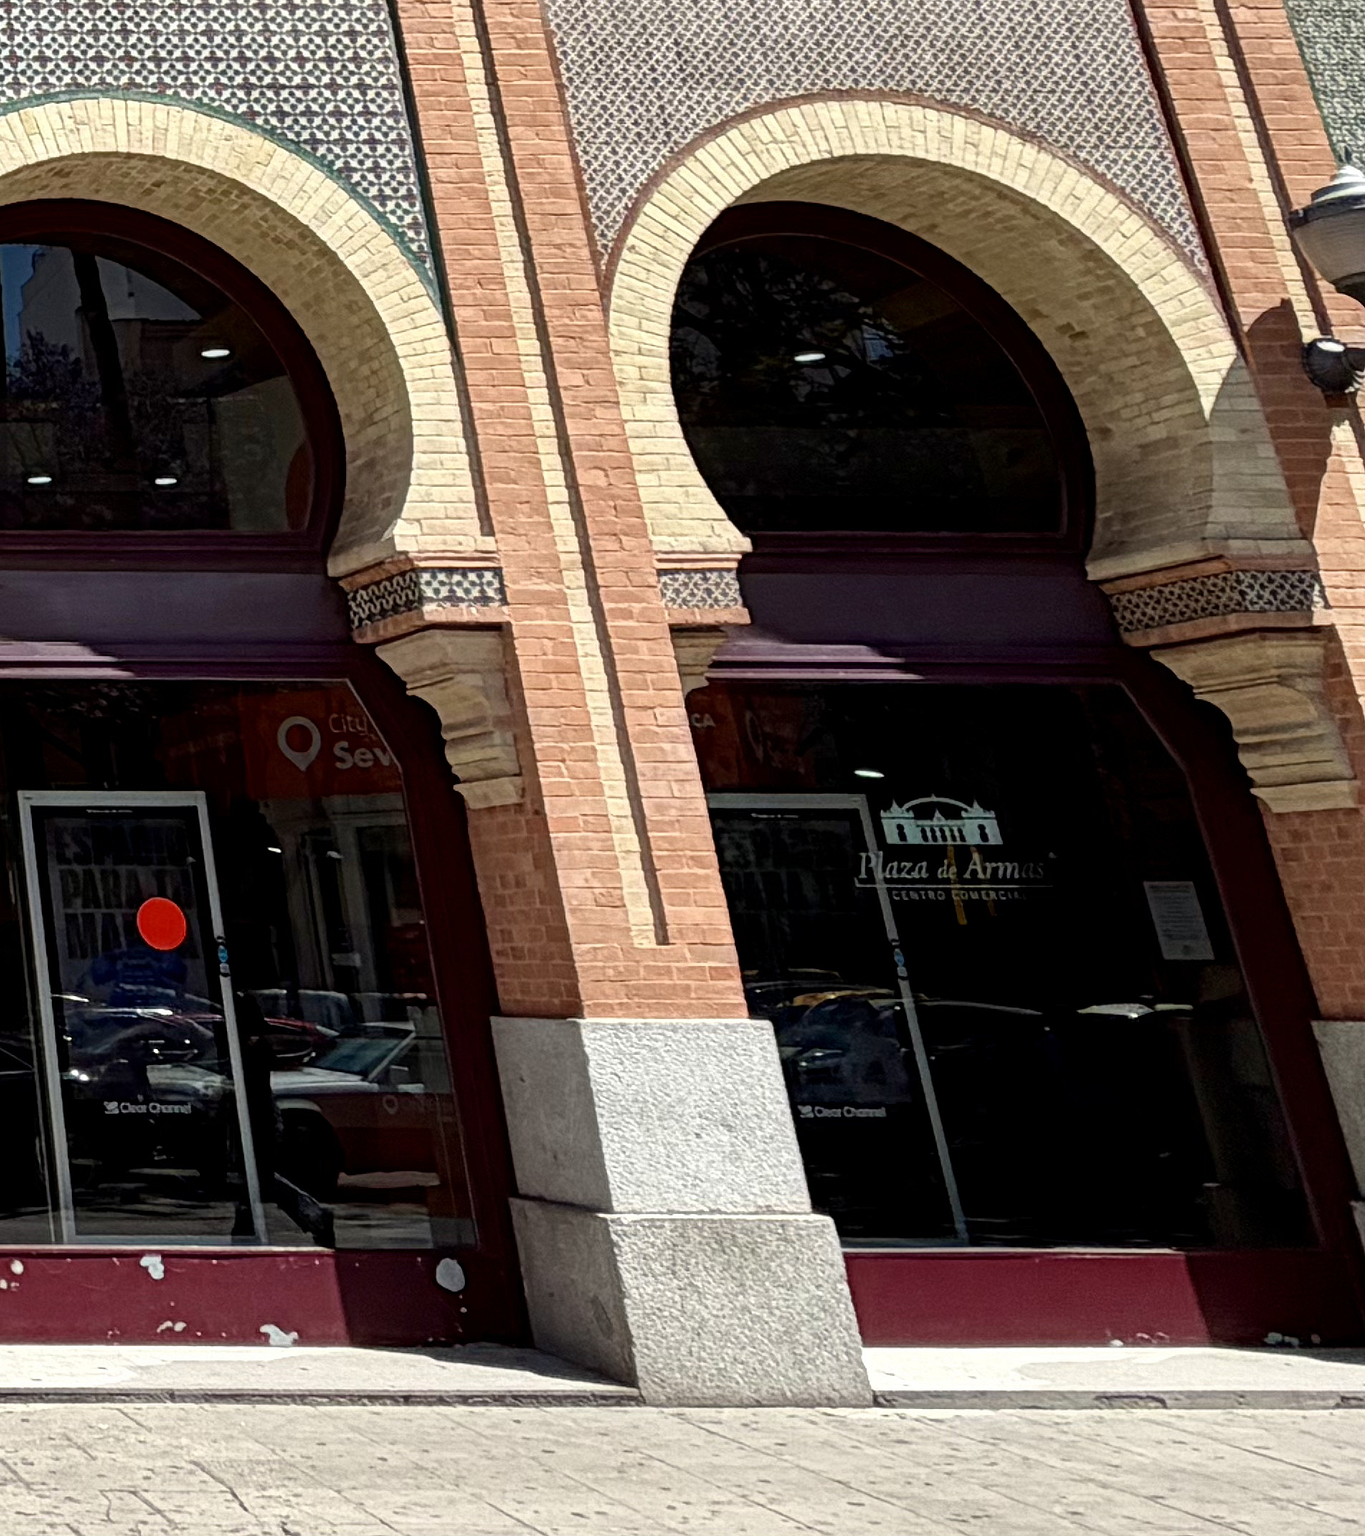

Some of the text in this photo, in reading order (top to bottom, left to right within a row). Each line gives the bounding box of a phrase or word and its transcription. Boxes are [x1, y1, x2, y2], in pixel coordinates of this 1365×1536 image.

[858, 849, 1044, 879] Plaza de Armas
